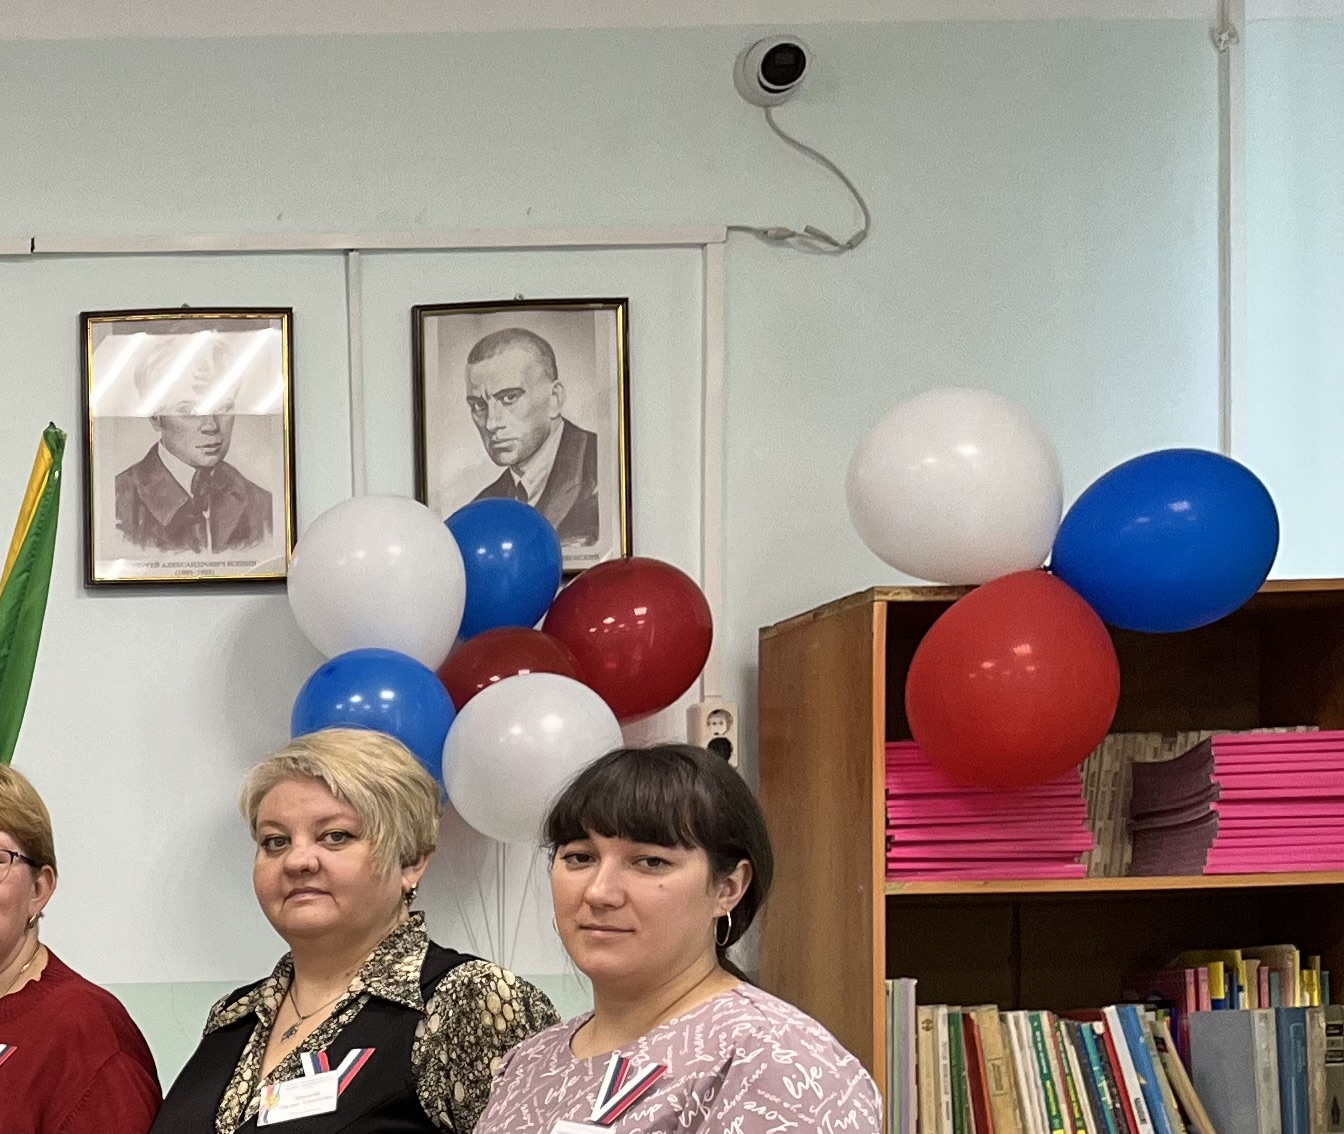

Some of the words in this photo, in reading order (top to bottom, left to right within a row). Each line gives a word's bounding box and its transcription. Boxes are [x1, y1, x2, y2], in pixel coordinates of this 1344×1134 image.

[716, 1063, 767, 1120] adventure
[782, 1062, 824, 1100] life
[742, 1101, 799, 1134] Love
